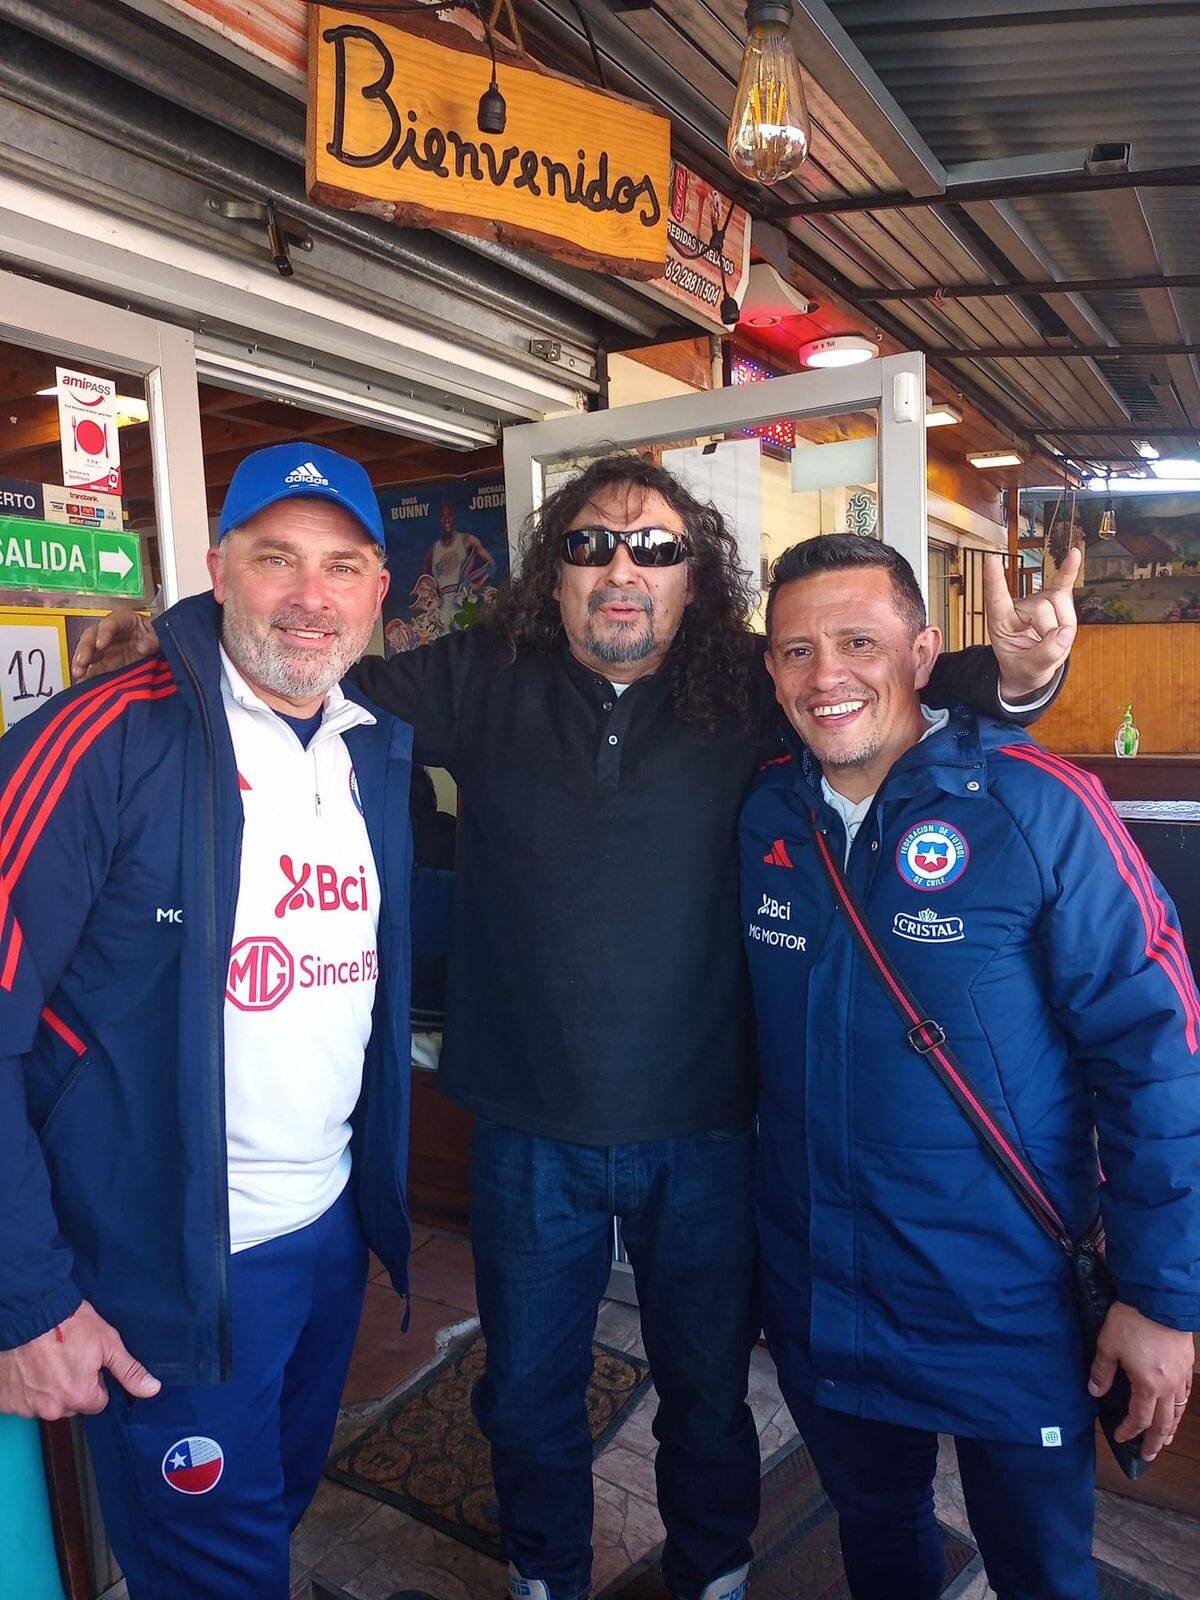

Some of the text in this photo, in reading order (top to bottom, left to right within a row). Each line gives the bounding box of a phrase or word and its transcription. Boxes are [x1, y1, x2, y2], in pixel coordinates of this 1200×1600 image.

[322, 24, 662, 227] Bienvenidos
[62, 375, 111, 396] amiPASS
[285, 474, 329, 486] adidas
[391, 503, 430, 520] BUNNY
[7, 648, 54, 702] 12
[938, 825, 950, 836] DE
[949, 833, 965, 859] FUTBOL
[316, 864, 369, 911] Bci
[913, 876, 946, 888] DE CHILE
[748, 923, 807, 952] MG MOTOR
[898, 918, 958, 938] CRISTAL
[229, 945, 287, 1003] MG
